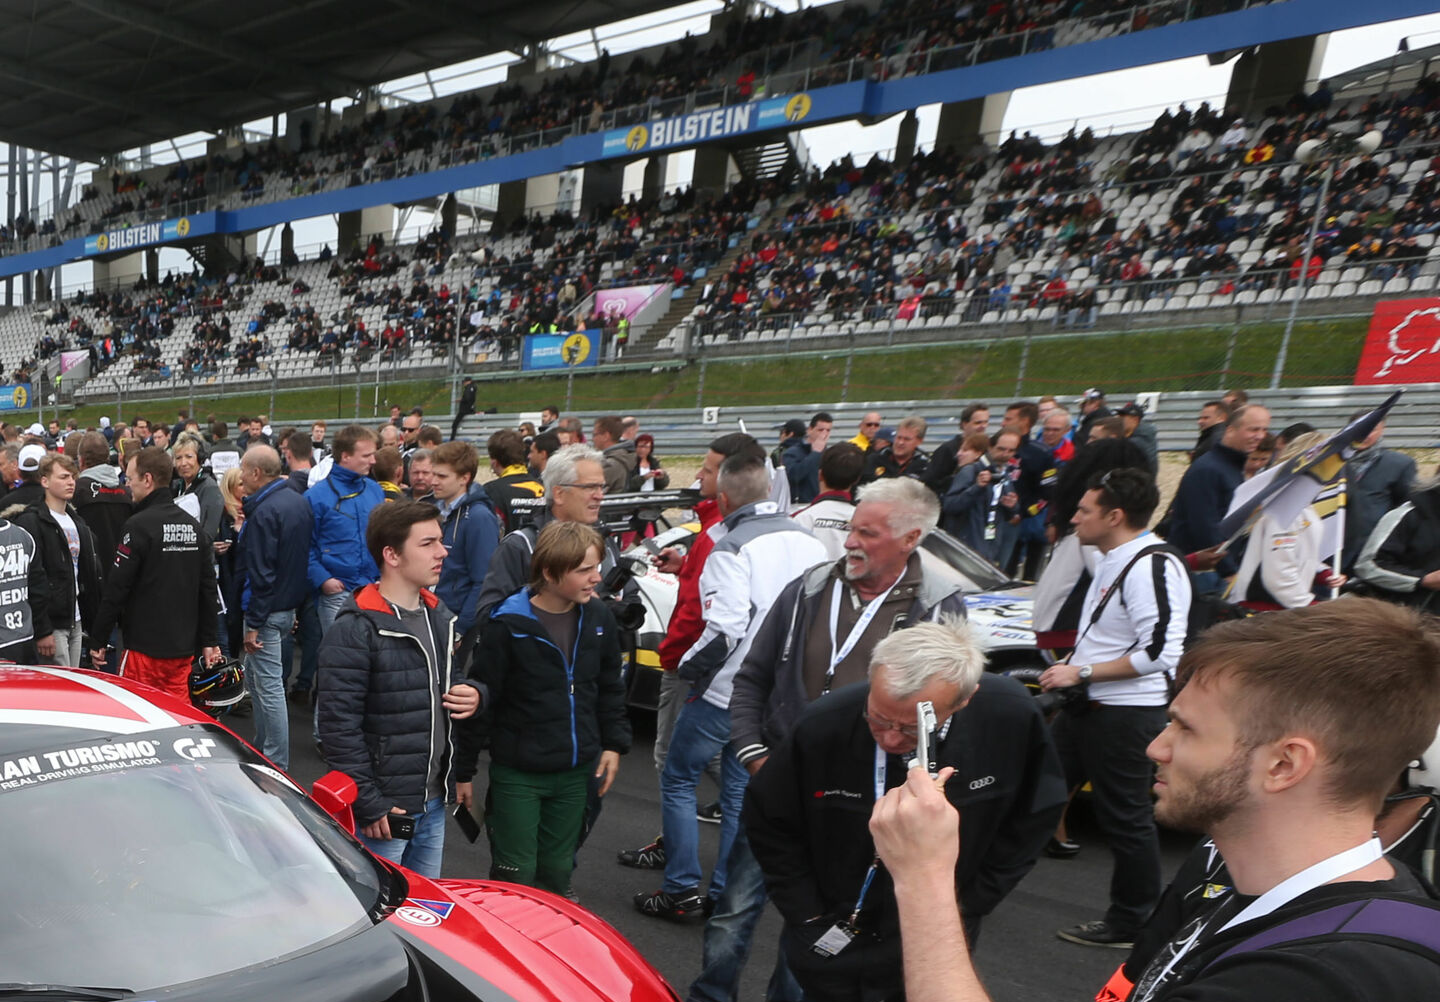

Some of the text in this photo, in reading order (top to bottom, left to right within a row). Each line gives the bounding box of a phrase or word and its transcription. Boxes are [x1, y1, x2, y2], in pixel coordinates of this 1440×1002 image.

[650, 104, 751, 148] BILSTEIN
[109, 223, 161, 250] BILSTEIN
[163, 524, 194, 533] HOFOR
[163, 533, 197, 542] RACING
[4, 611, 24, 629] 83
[43, 741, 157, 769] TURISMO
[2, 777, 37, 791] REAL
[38, 766, 91, 783] DRIVING
[92, 756, 162, 773] SIMULATOR
